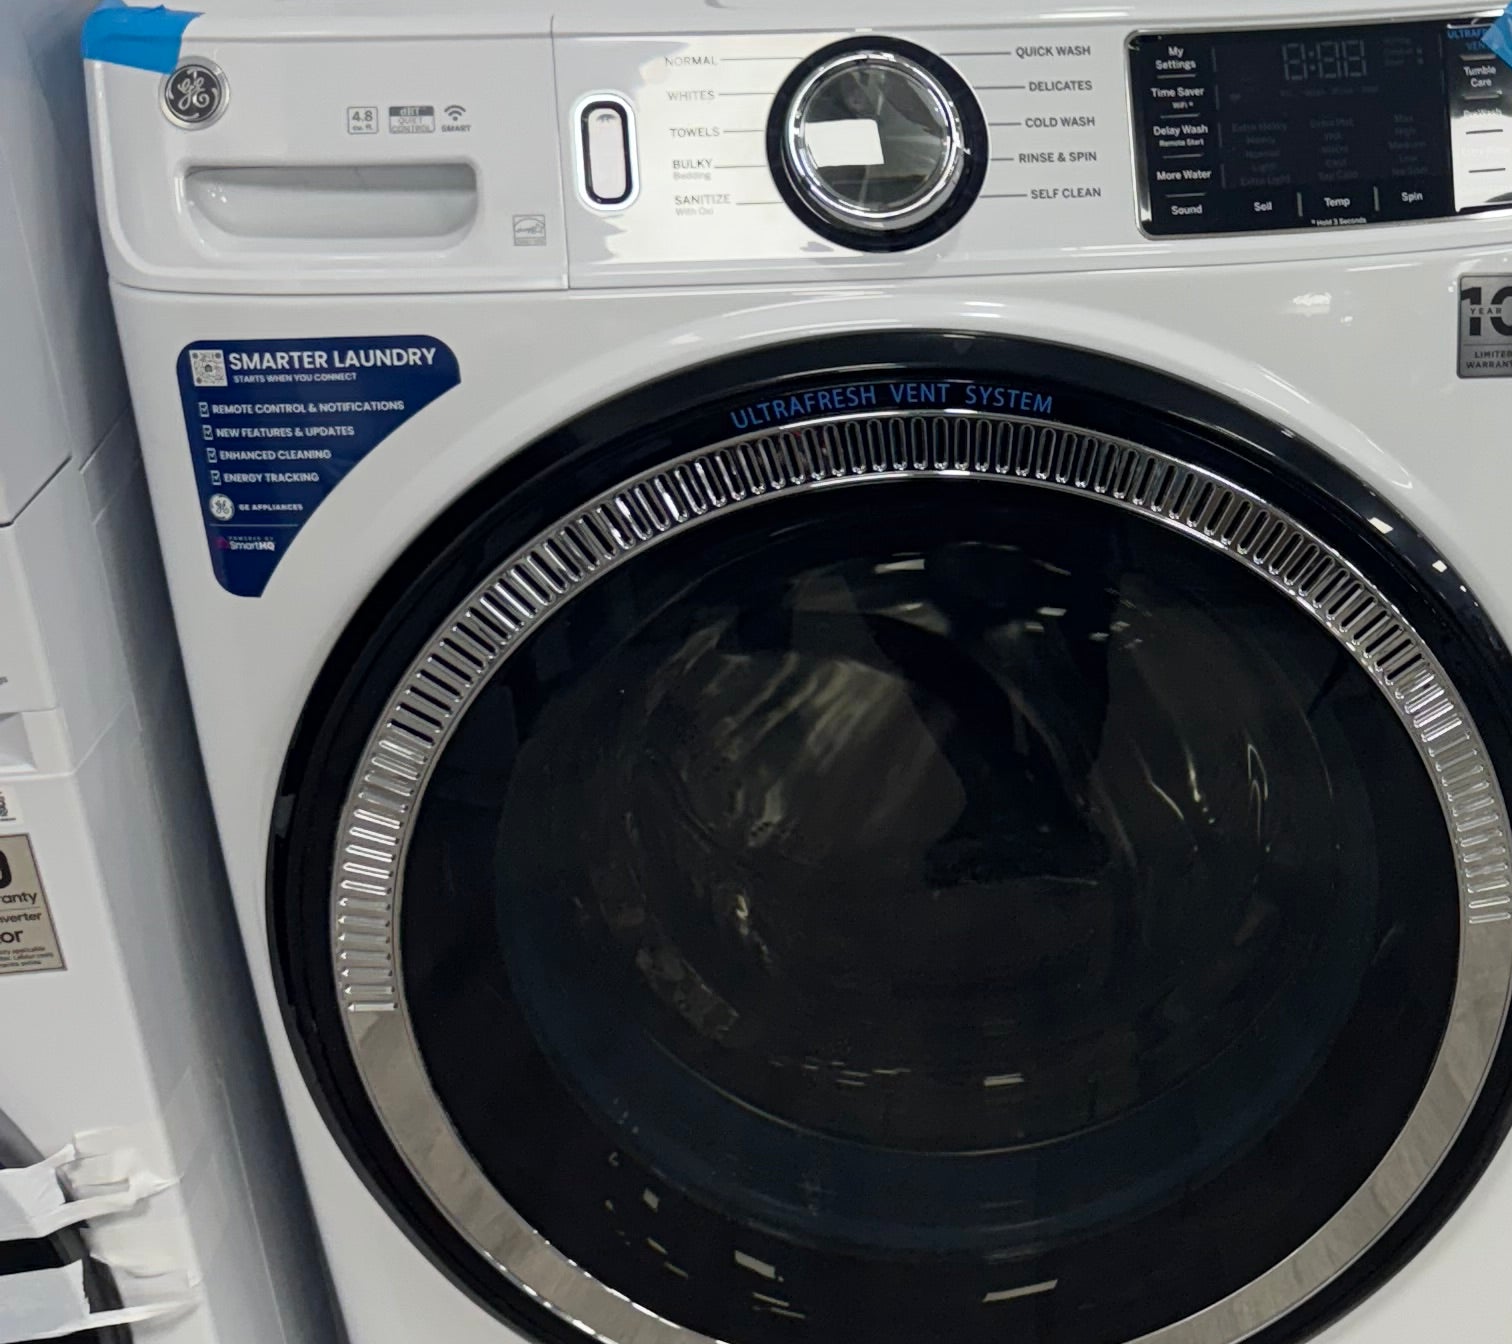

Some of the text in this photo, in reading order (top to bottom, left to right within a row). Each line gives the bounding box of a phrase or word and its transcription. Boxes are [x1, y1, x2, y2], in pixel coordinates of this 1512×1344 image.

[1016, 46, 1091, 59] QUICK WASH
[1168, 45, 1184, 58] My
[664, 56, 719, 67] NORMAL
[1155, 59, 1197, 71] Settings
[1463, 65, 1497, 76] Tumble
[1028, 80, 1093, 92] DELICATES
[1470, 78, 1492, 88] Care
[667, 91, 716, 101] WHITES
[1151, 86, 1205, 98] Time Saver
[352, 110, 373, 122] 4.8
[1025, 116, 1095, 128] COLD WASH
[391, 125, 431, 134] CONTROL
[441, 125, 472, 133] SMART
[670, 127, 720, 138] TOWELS
[1153, 123, 1208, 137] Delay Wash
[1018, 151, 1097, 164] RINSE & SPIN
[672, 159, 713, 170] BULKY
[1156, 169, 1212, 181] More Water
[1031, 187, 1101, 199] SELF CLEAN
[1401, 190, 1424, 204] Spin
[674, 194, 732, 206] SANITIZE
[1253, 200, 1273, 212] Soil
[1324, 196, 1351, 210] Temp
[1171, 204, 1203, 216] Sound
[1470, 307, 1502, 315] YEAR
[228, 347, 437, 371] SMARTER LAUNDRY
[233, 372, 358, 384] STARTS WHEN YOU CONNECT
[212, 400, 405, 415] REMOTE CONTROL & NOTIFICATIONS
[730, 383, 1054, 429] ULTRAFRESH VENT SYSTEM
[216, 425, 355, 438] NEW FEATURES & UPDATES
[219, 449, 332, 461] ENHANCED CLEANING
[223, 471, 320, 483] ENERGY TRACKING
[251, 503, 304, 511] APPLIANCES
[229, 540, 276, 551] SmartHQ
